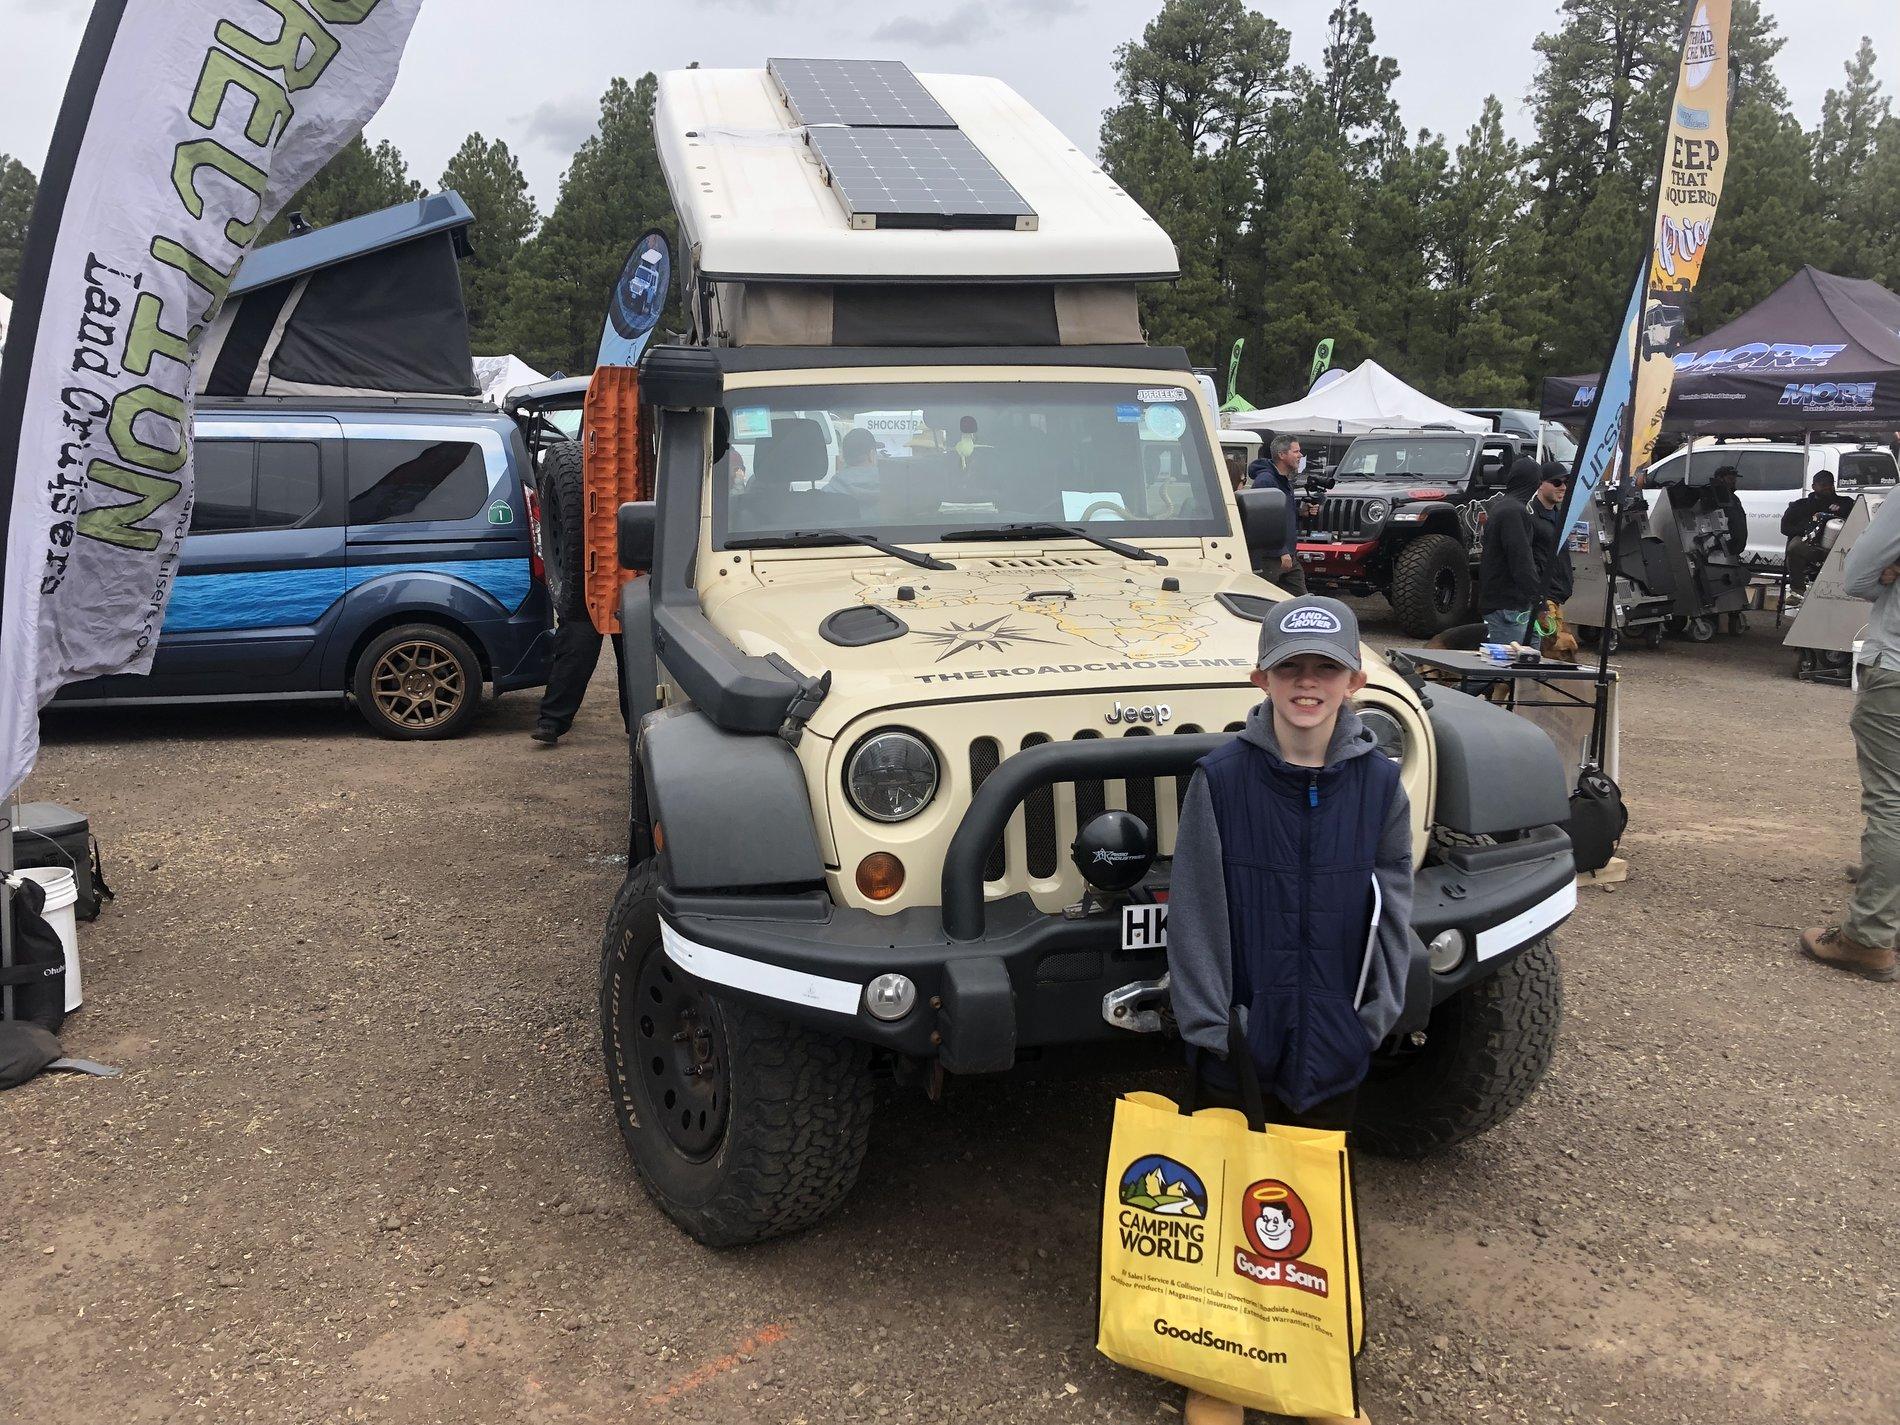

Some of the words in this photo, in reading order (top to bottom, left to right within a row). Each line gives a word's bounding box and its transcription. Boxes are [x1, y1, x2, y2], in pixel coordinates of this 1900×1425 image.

[1671, 170, 1707, 187] THAT
[72, 251, 143, 378] Land
[40, 386, 111, 595] Cruisers
[498, 509, 503, 521] 1
[1291, 612, 1322, 622] LAND
[1294, 618, 1332, 629] ROVER
[1104, 700, 1172, 726] Jeep
[616, 928, 634, 962] T/A
[611, 971, 641, 1128] All-Terrain
[1119, 1210, 1204, 1243] CAMPING
[1119, 1227, 1204, 1264] WORLD
[1128, 1271, 1143, 1280] Sales
[1147, 1275, 1169, 1285] Service
[1176, 1281, 1203, 1293] Collision
[1206, 1288, 1224, 1298] Clubs
[1236, 1252, 1281, 1281] Good
[1285, 1264, 1327, 1292] Sam
[1133, 1282, 1164, 1293] Products
[1168, 1290, 1202, 1303] Magazines
[1206, 1299, 1238, 1311] Insurance
[1271, 1316, 1310, 1328] Warranties
[1314, 1325, 1333, 1338] Shows
[1154, 1318, 1287, 1363] GoodSam.com
